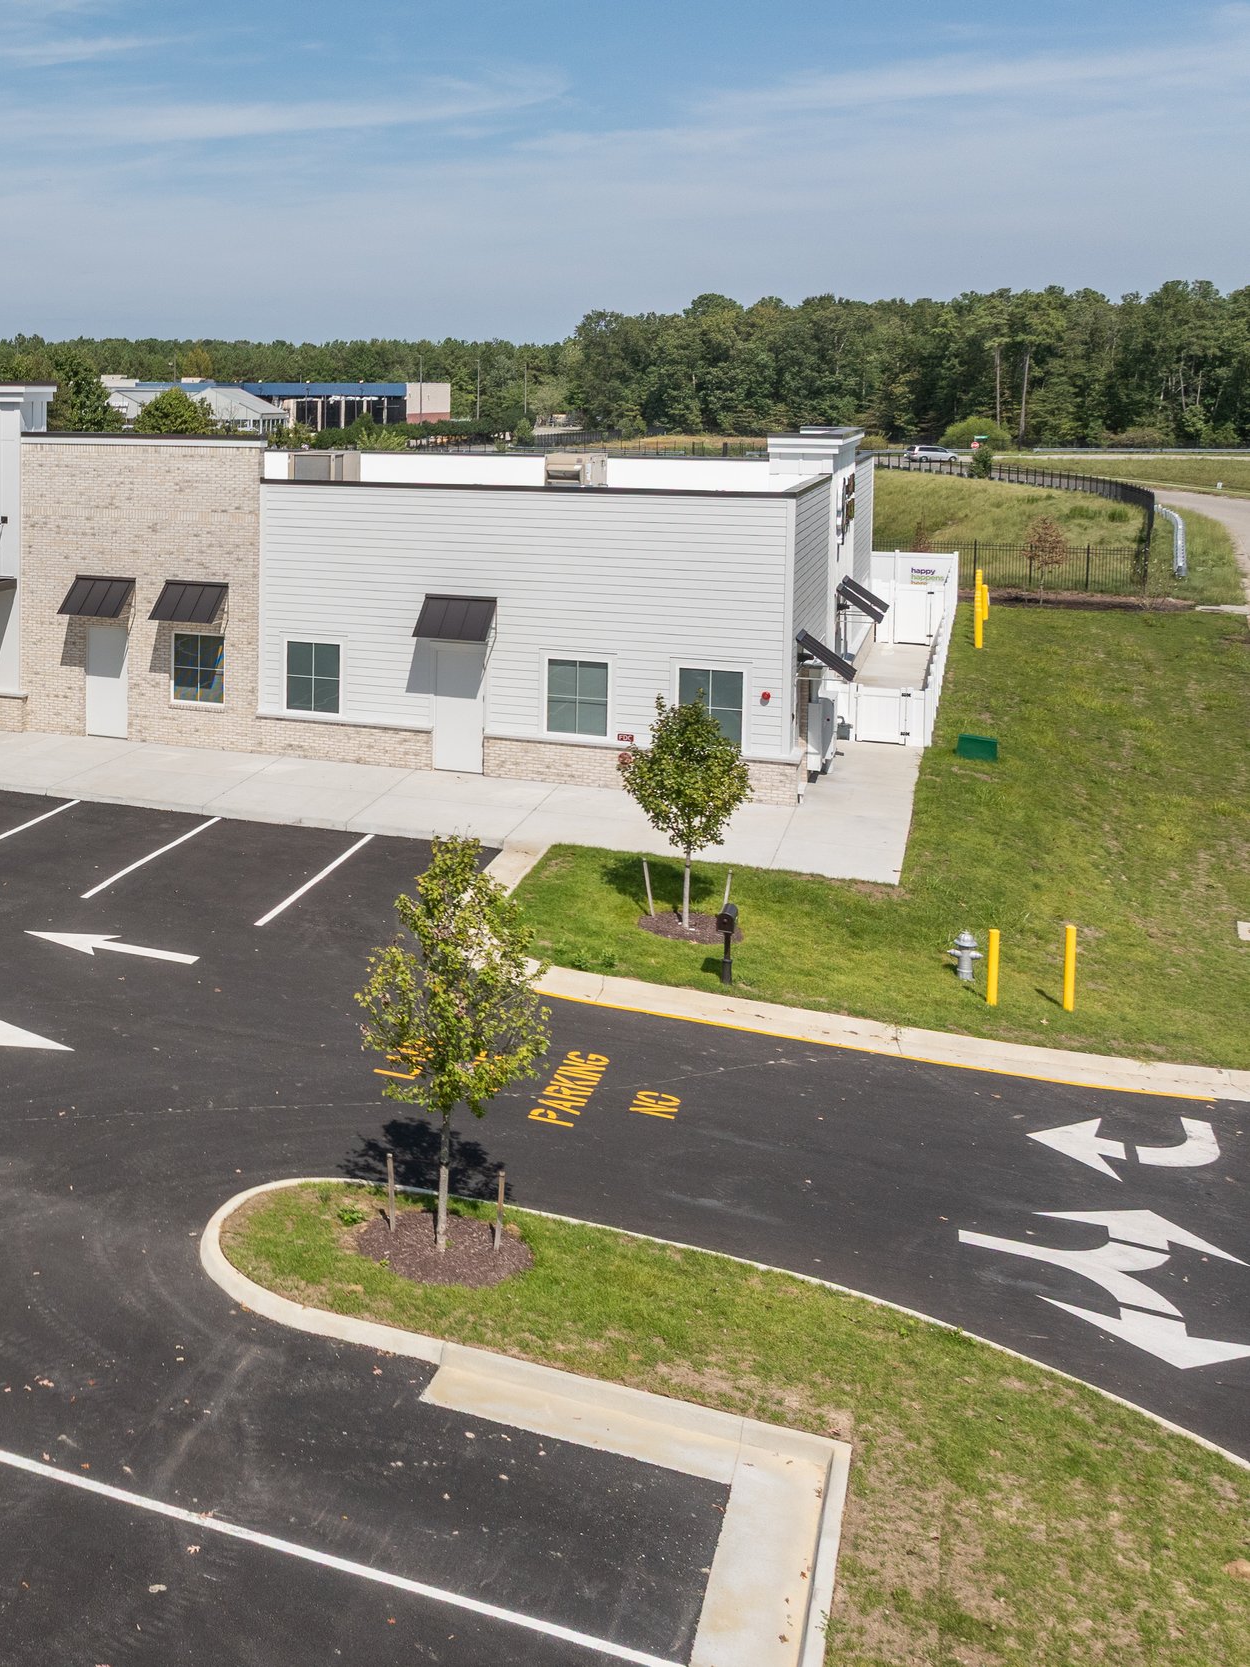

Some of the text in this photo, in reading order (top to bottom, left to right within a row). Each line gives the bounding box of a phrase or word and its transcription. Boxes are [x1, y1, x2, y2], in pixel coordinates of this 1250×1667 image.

[911, 567, 936, 575] happy
[527, 1051, 610, 1128] PARKING
[629, 1090, 681, 1120] NO
